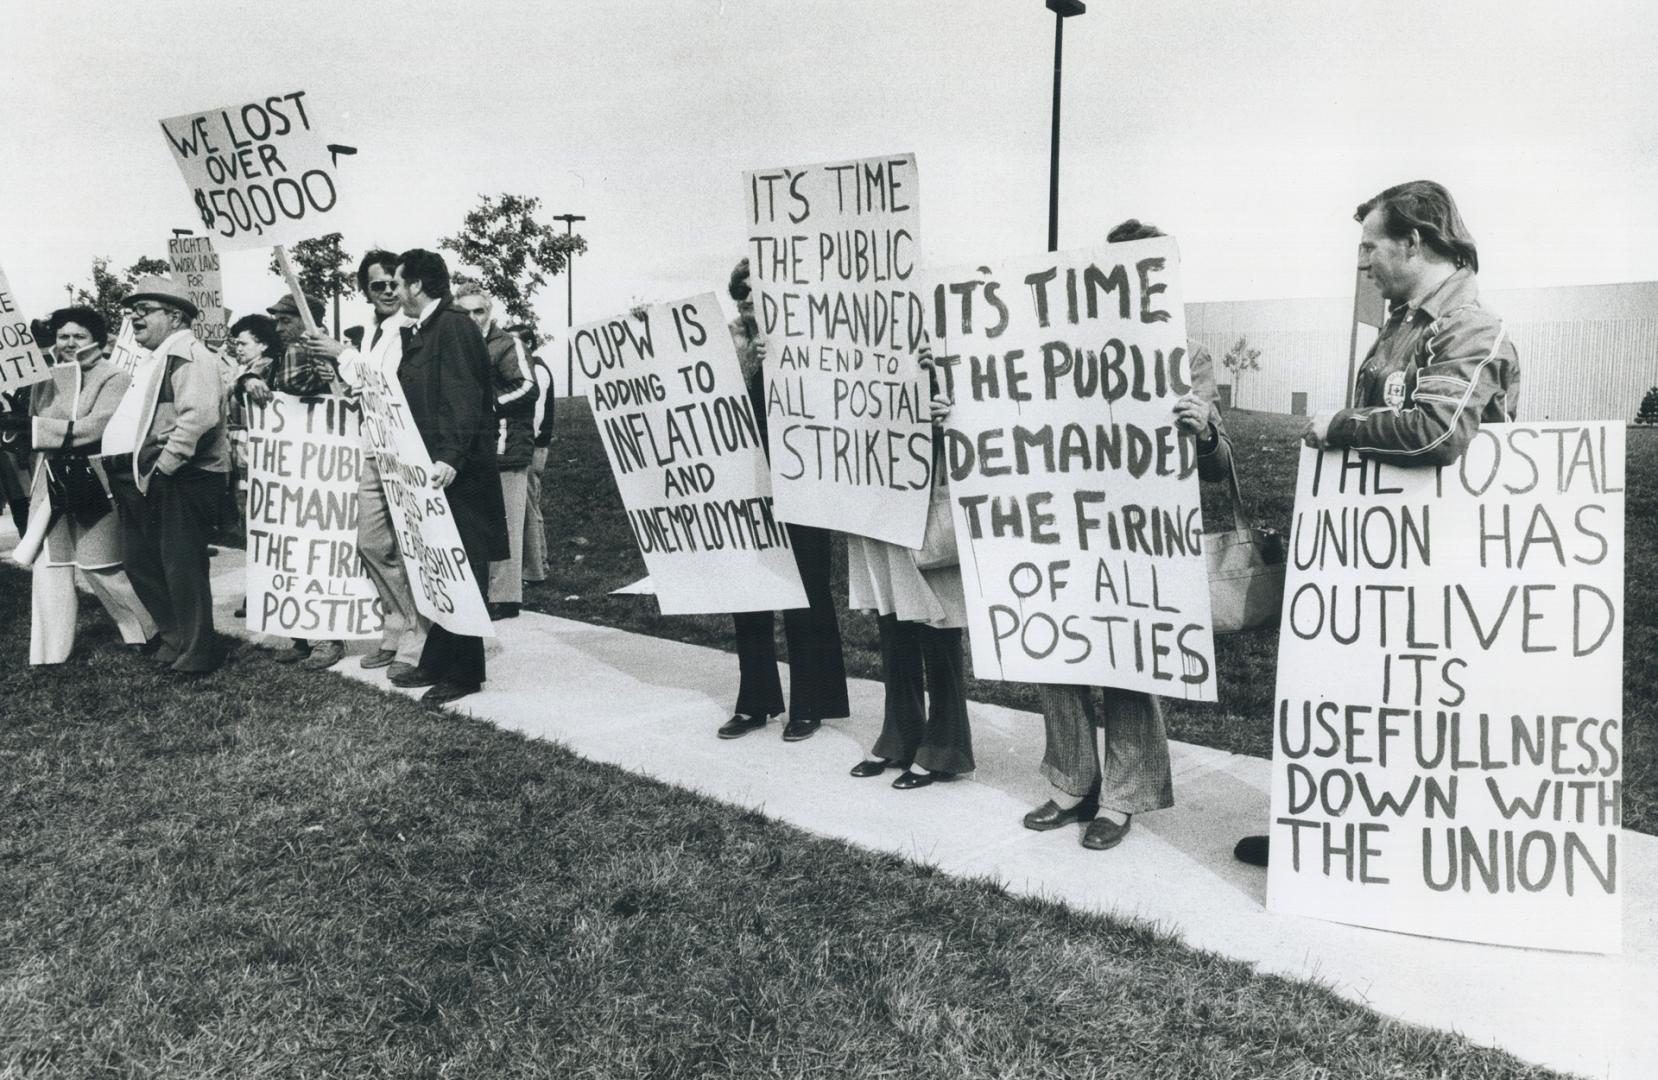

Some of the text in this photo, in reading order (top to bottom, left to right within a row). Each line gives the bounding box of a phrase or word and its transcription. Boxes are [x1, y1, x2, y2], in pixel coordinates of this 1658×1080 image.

[161, 90, 310, 158] WE LOST
[205, 144, 287, 184] OVER
[752, 160, 910, 224] IT'S TIME
[194, 169, 337, 238] $50,000
[187, 274, 205, 288] FOR
[750, 228, 913, 284] THE PUBLIC
[762, 290, 924, 354] DEMANDED
[934, 256, 1172, 338] IT'S TIME
[575, 303, 707, 379] CUPW IS
[780, 345, 898, 374] AN END TO
[935, 337, 1192, 405] THE PUBLIC
[299, 396, 364, 437] TIM
[595, 361, 715, 411] ADDING TO
[768, 375, 932, 424] ALL POSTAL
[249, 437, 293, 477] THE
[300, 442, 362, 483] PUBL
[604, 395, 760, 474] INFLATION
[780, 424, 930, 491] STRIKES
[945, 422, 1198, 481] DEMANDED
[426, 497, 445, 516] AS
[665, 463, 715, 498] AND
[250, 529, 298, 573] THE
[958, 489, 1202, 558] THE FIRING
[1294, 503, 1610, 571] UNION HAS
[262, 591, 385, 635] POSTIES
[272, 574, 356, 597] OF ALL
[1008, 557, 1180, 613] OF ALL
[989, 605, 1210, 685] POSTIES
[1289, 582, 1615, 657] OUTLIVED
[1383, 653, 1468, 707] ITS
[1279, 699, 1620, 778] USEFULLNESS
[1288, 764, 1622, 827] DOWN WITH
[1276, 818, 1617, 897] THE UNION
